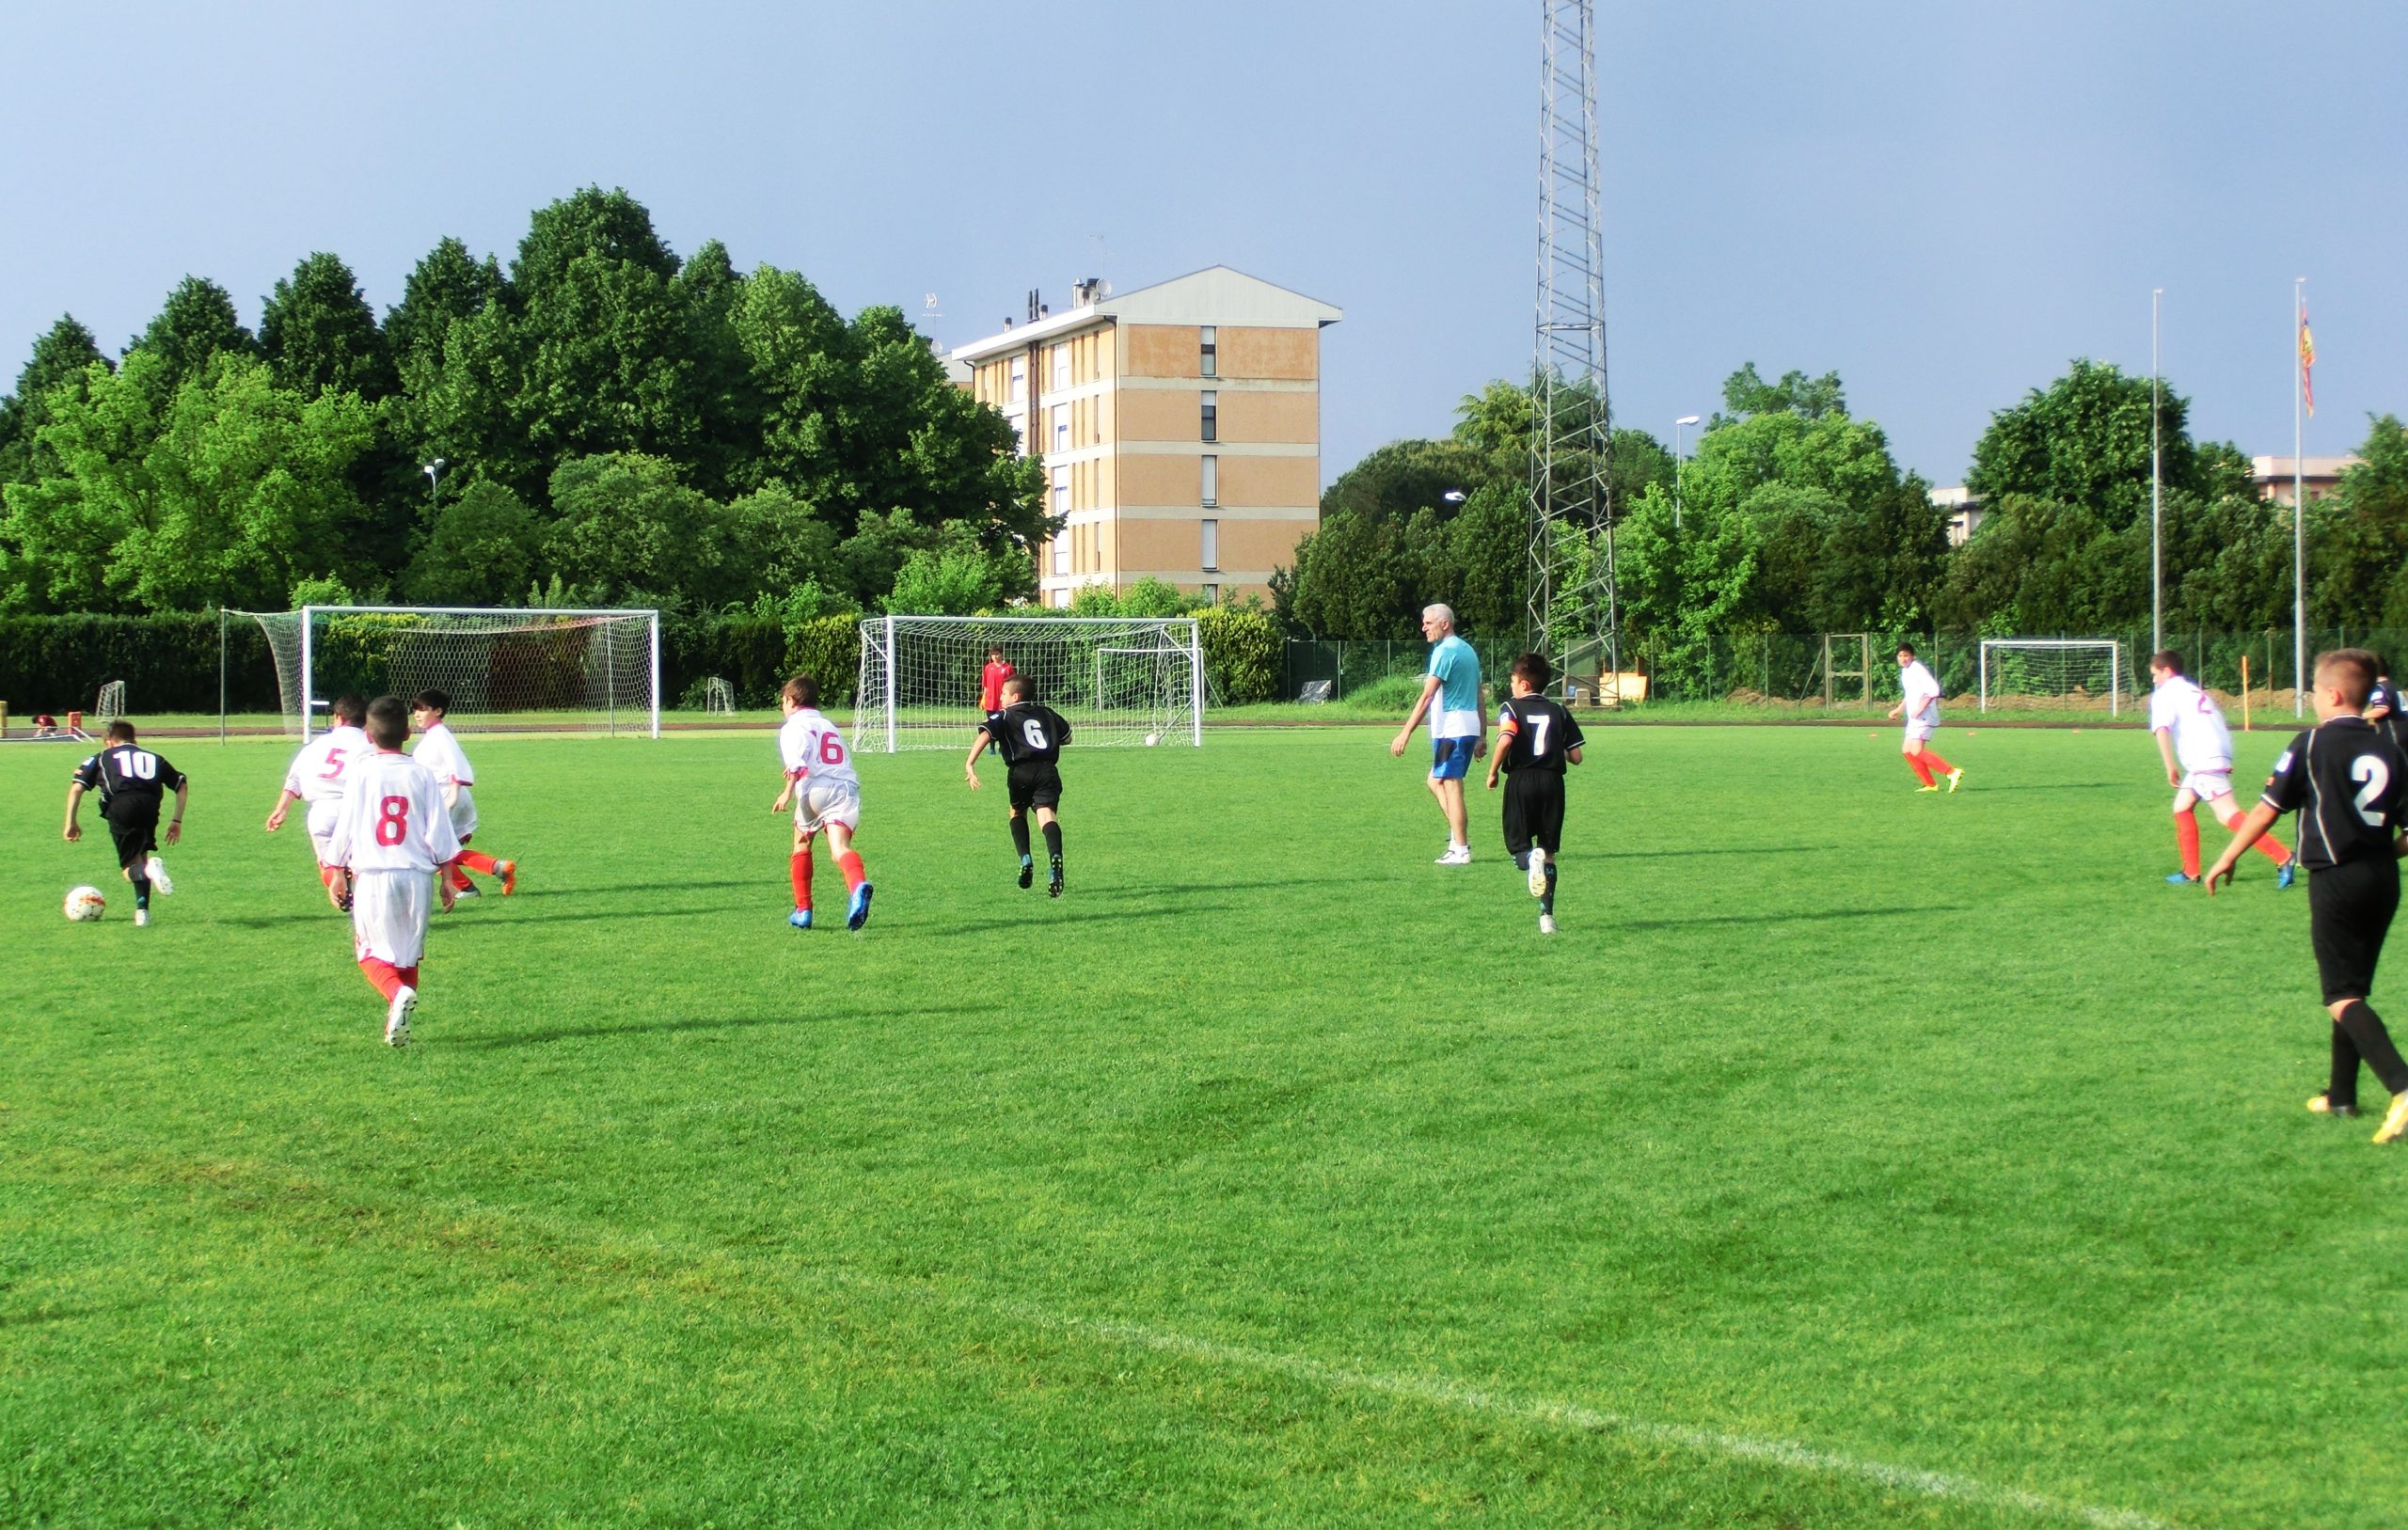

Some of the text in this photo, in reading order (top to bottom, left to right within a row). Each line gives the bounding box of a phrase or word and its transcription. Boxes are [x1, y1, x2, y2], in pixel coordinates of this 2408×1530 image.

[810, 730, 843, 765] 6
[1022, 718, 1048, 749] 6
[1527, 715, 1550, 756] 7
[113, 750, 157, 781] 10
[317, 748, 348, 780] 5
[2352, 755, 2389, 827] 2
[375, 796, 409, 846] 8
